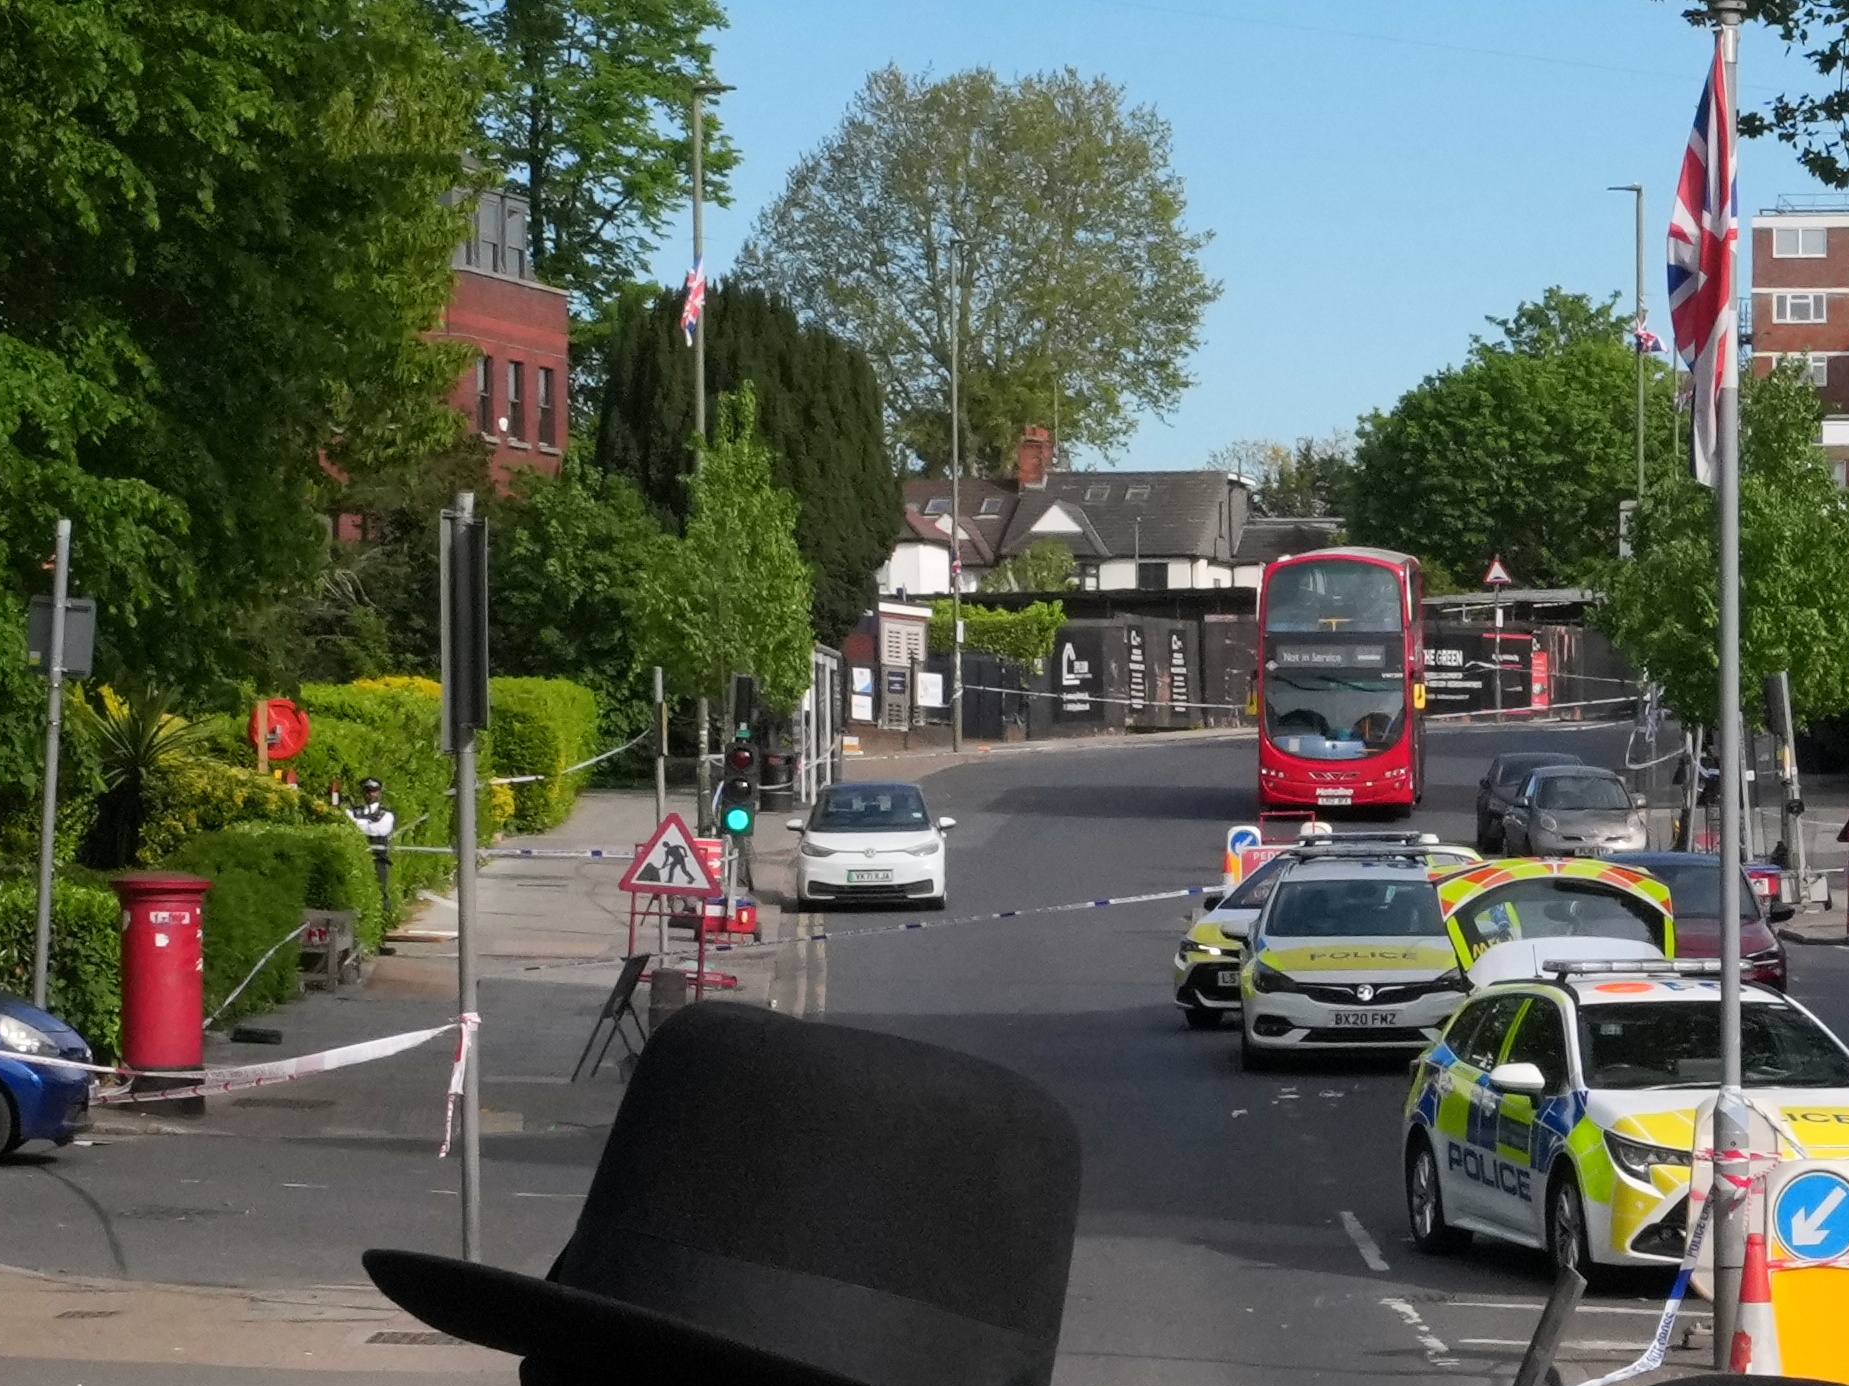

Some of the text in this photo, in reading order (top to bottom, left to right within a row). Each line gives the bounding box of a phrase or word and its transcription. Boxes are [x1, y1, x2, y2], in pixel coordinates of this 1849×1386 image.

[1309, 951, 1418, 962] POLICE
[1334, 1013, 1368, 1026] BX20
[1448, 1140, 1532, 1203] POLICE
